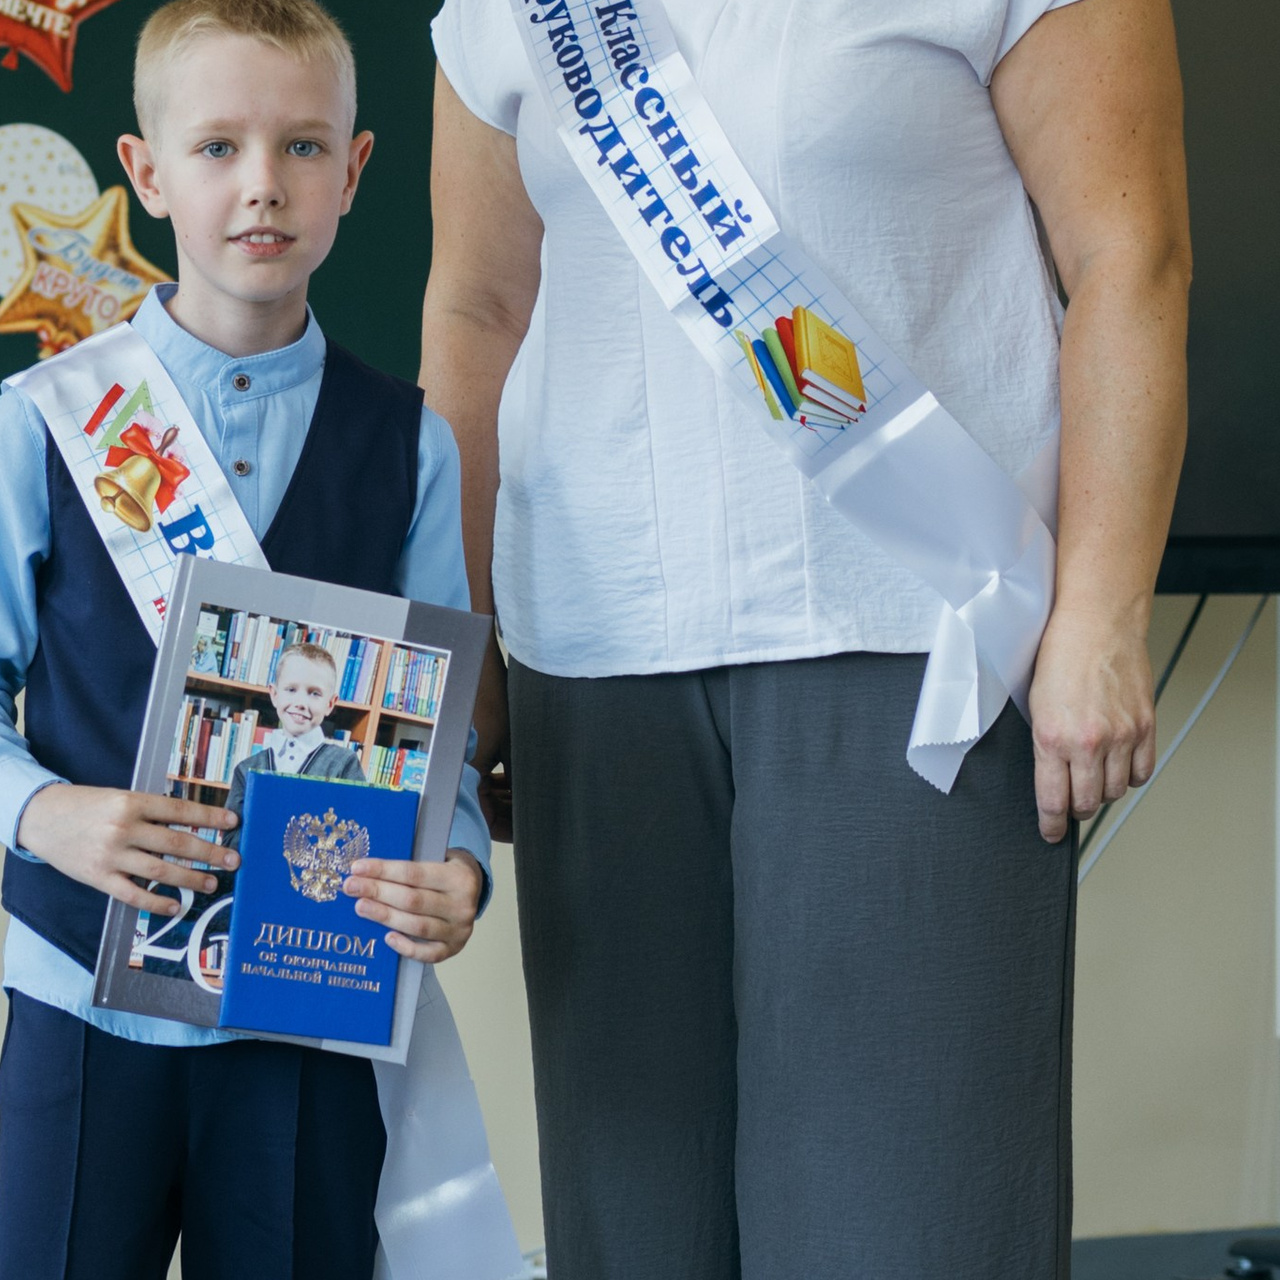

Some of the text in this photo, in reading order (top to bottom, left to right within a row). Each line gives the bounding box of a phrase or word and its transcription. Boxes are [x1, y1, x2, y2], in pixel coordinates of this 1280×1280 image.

[28, 228, 141, 292] Будет
[30, 261, 123, 323] КРУТО
[253, 922, 378, 959] ДИПЛОМ
[240, 962, 381, 994] НАЧАЛЬНОЙ ШКОЛЫ
[258, 950, 368, 976] ОБ ОКОНЧАНИИ
